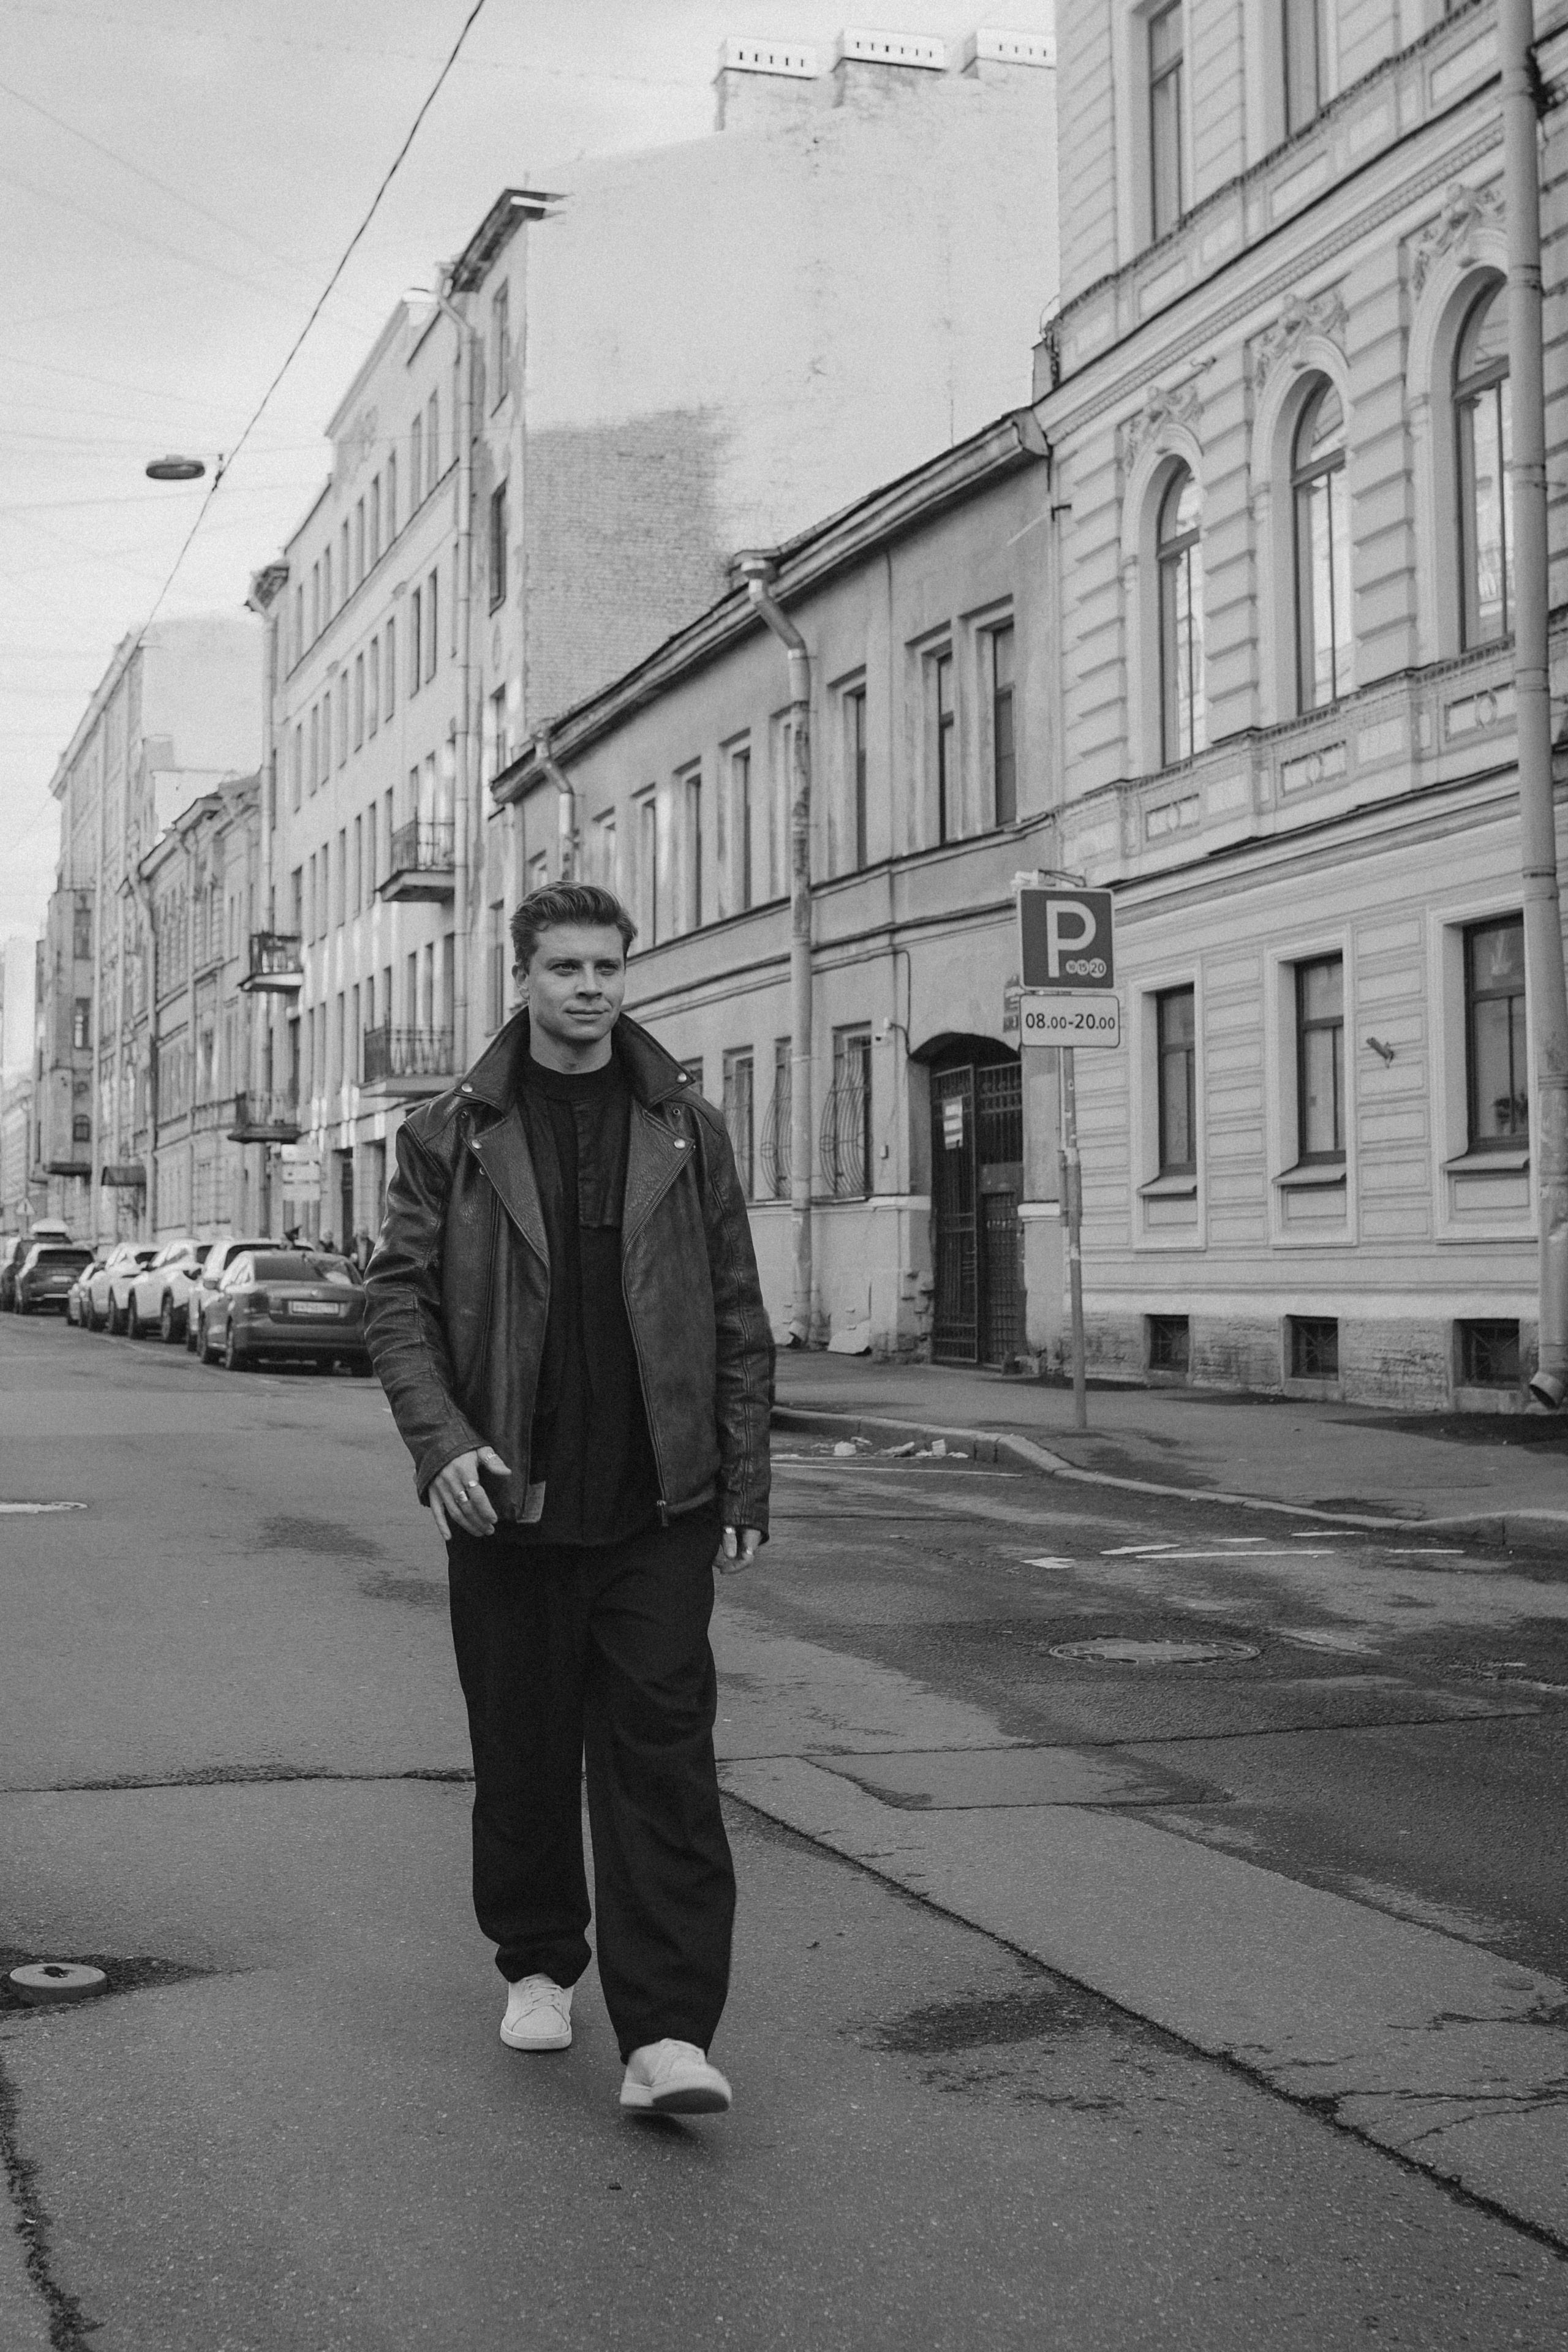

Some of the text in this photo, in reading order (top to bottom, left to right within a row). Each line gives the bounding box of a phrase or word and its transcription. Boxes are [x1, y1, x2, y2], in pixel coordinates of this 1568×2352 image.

[1046, 900, 1096, 978] P
[1078, 962, 1087, 971] 15
[1091, 962, 1105, 974] 20
[1025, 1012, 1115, 1030] 08.00-20.00
